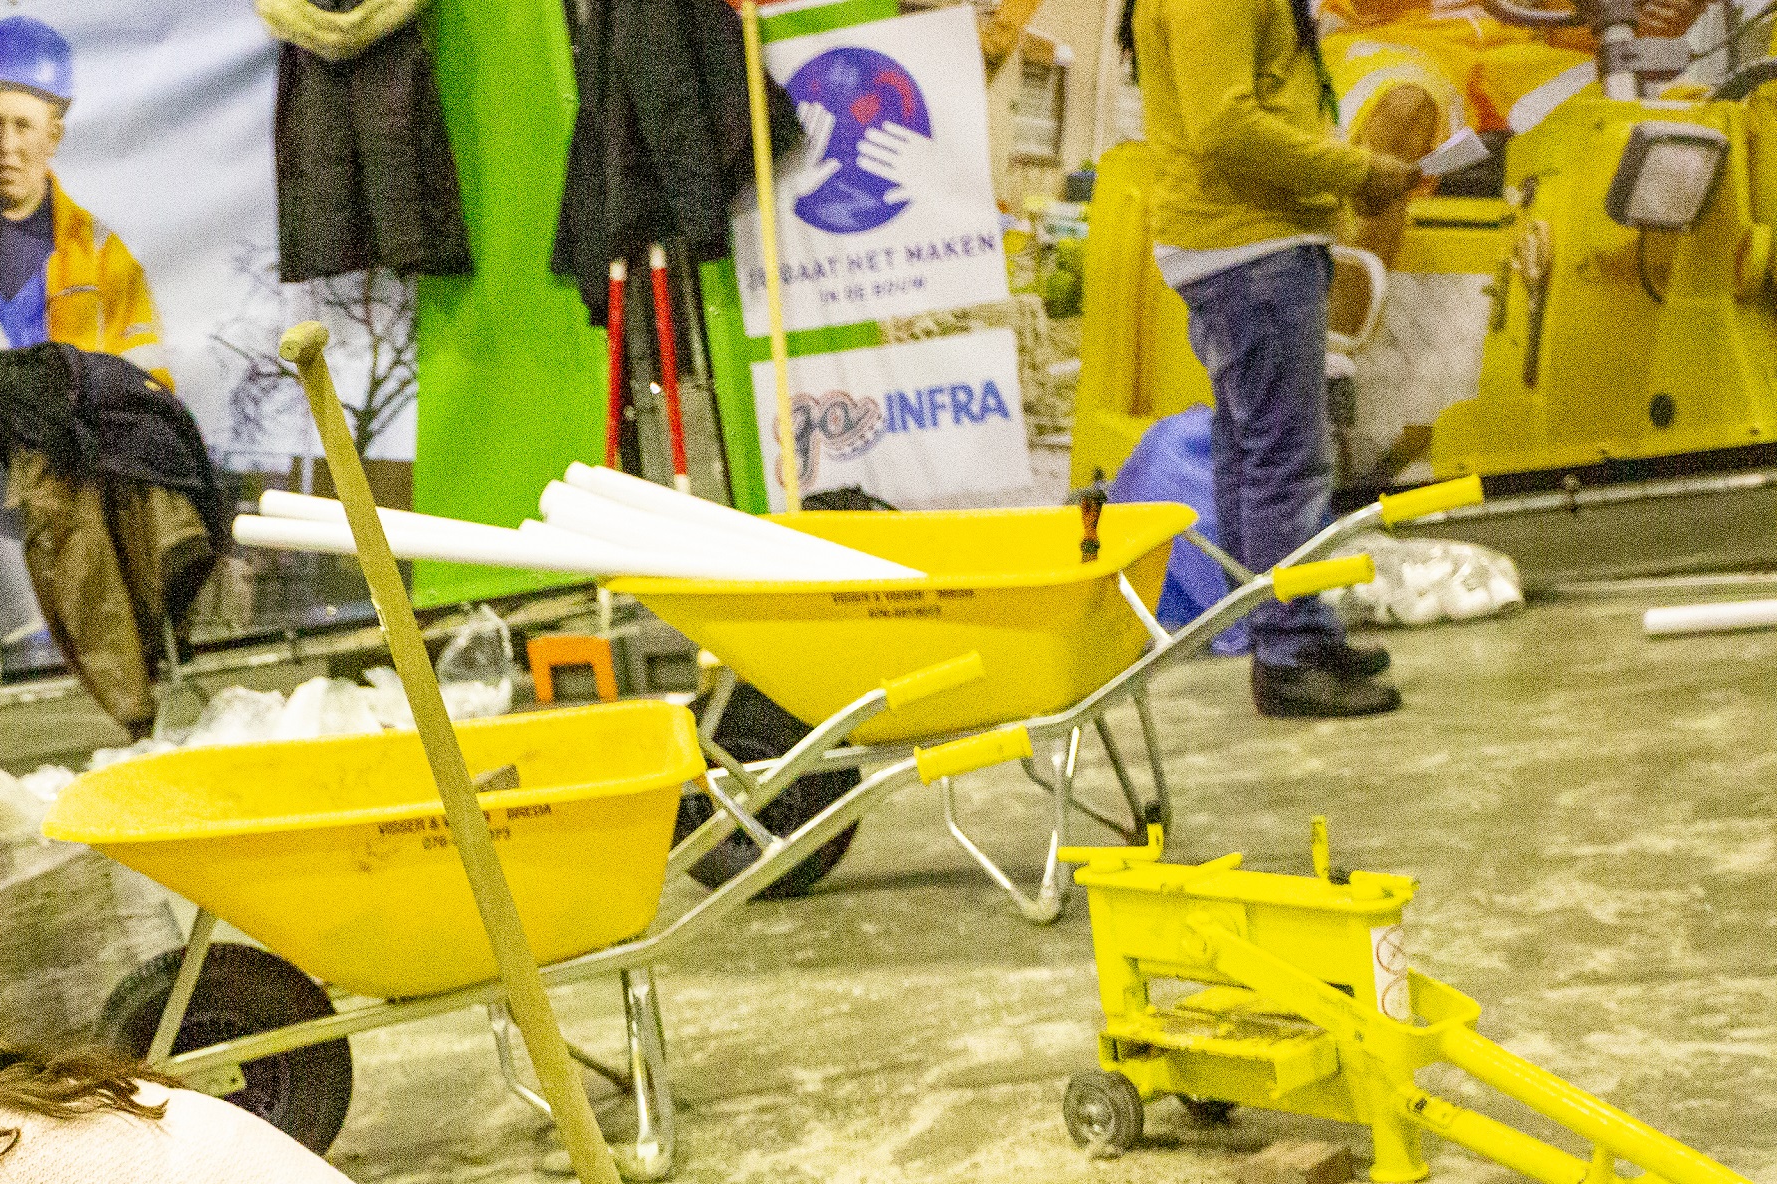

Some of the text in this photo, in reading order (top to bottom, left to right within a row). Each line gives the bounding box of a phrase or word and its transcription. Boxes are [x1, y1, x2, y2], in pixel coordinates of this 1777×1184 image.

[846, 248, 895, 275] HET
[905, 233, 997, 266] MAKEN
[883, 379, 1012, 435] INFRA
